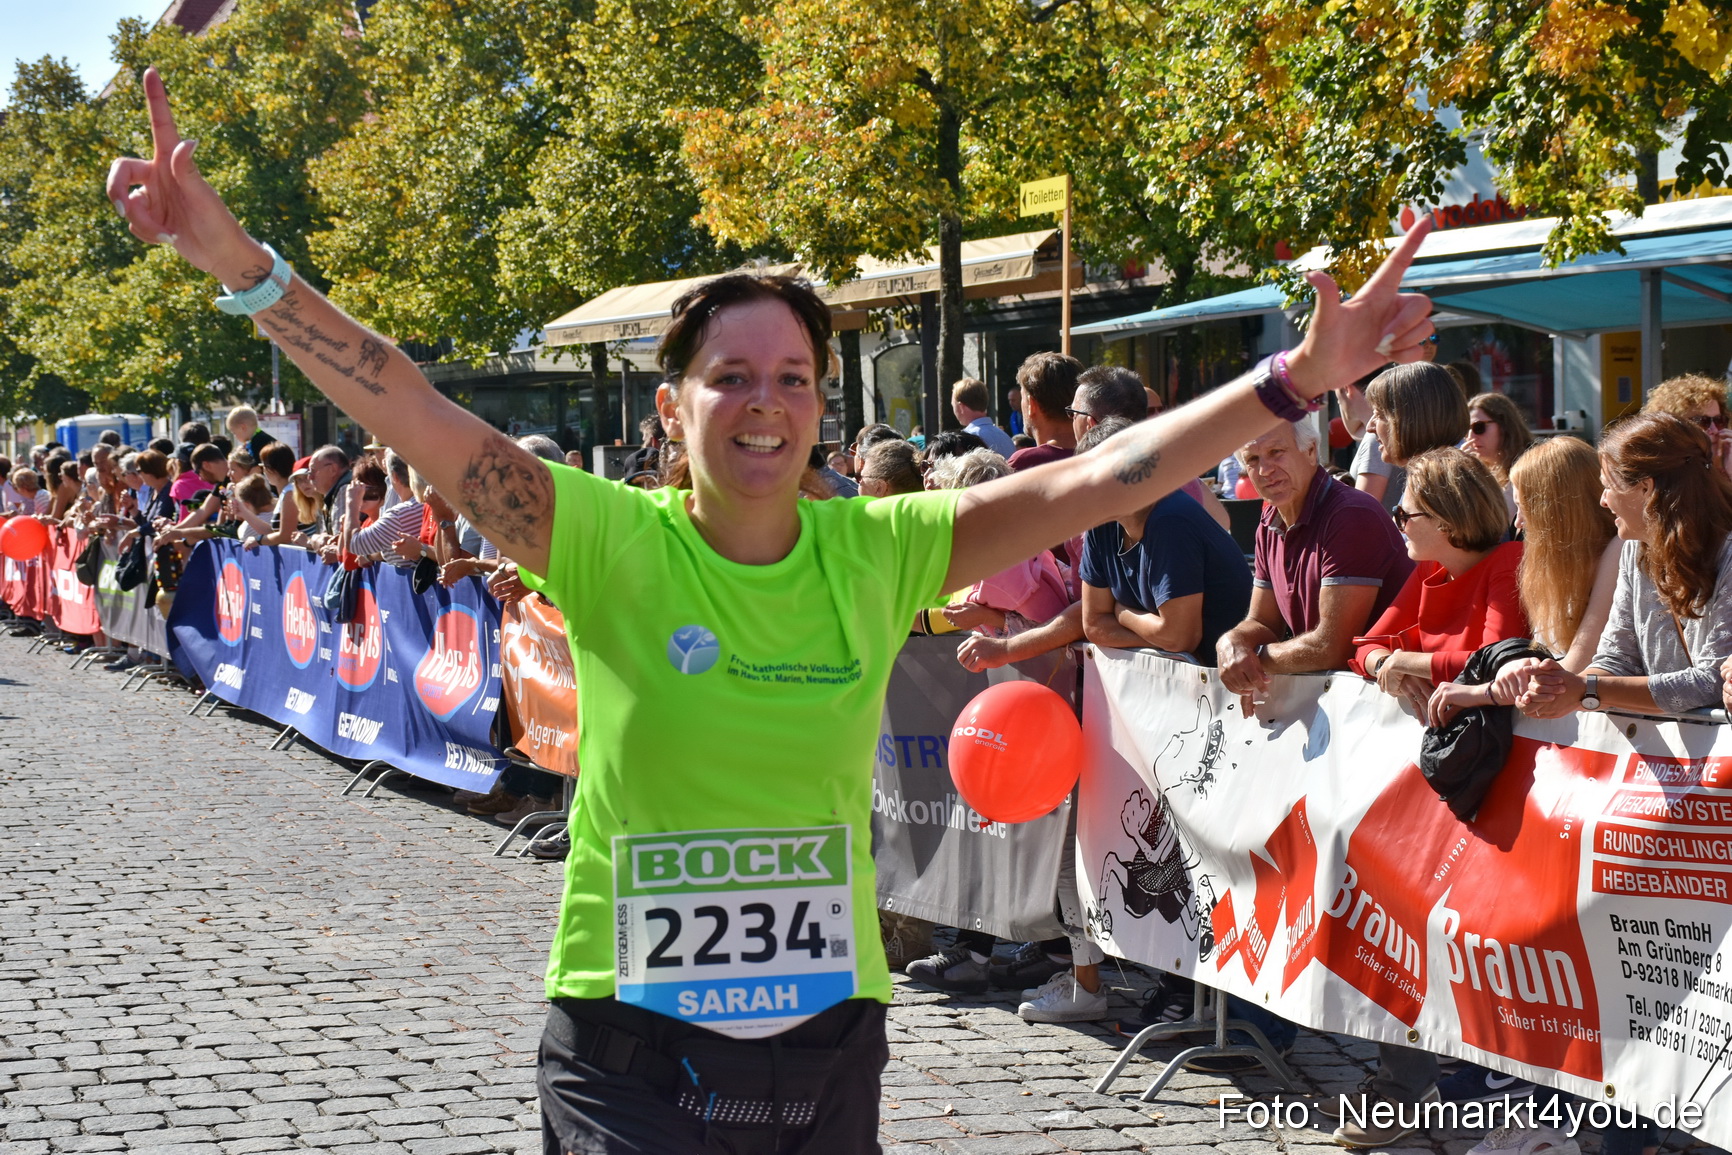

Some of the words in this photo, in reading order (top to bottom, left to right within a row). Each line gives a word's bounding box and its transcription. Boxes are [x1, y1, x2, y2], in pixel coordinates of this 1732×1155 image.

[1030, 189, 1063, 205] Toiletten
[1434, 194, 1536, 228] vodafo
[286, 593, 315, 646] Hervis
[421, 632, 478, 695] Hervis
[728, 666, 738, 675] im
[741, 670, 759, 680] Haus
[761, 674, 773, 682] St.
[776, 674, 804, 684] Marien,
[753, 663, 807, 673] katholische
[482, 697, 499, 712] MOBI
[528, 718, 569, 749] Agentur
[975, 739, 1005, 752] energie
[445, 742, 464, 768] GET
[876, 734, 948, 768] STR
[1634, 761, 1721, 782] BINDESTRICKE
[1616, 794, 1732, 820] VERZURRSYSTE
[635, 838, 830, 886] BOCK
[1435, 863, 1450, 881] Seit
[1450, 838, 1467, 863] 1929
[1603, 869, 1727, 898] HEBEBÄNDER
[832, 904, 841, 914] D
[1324, 862, 1420, 979] Braun
[645, 902, 827, 968] 2234
[1246, 902, 1266, 961] Braun
[1287, 896, 1312, 959] Braun
[1610, 914, 1659, 935] Braun
[1665, 919, 1711, 942] GmbH
[1443, 906, 1583, 1010] Braun
[1619, 938, 1641, 957] Am
[1647, 940, 1711, 974] Grünberg
[1715, 952, 1722, 973] 8
[1356, 946, 1383, 973] Sicher
[1385, 967, 1398, 983] ist
[1398, 974, 1425, 1004] sicher
[1622, 961, 1678, 987] D-92318
[678, 985, 798, 1015] SARAH
[1498, 1006, 1535, 1030] Sicher
[1541, 1015, 1558, 1033] ist
[1563, 1019, 1600, 1042] sicher
[1627, 995, 1650, 1016] Tel.
[1656, 1001, 1688, 1026] 09181
[1691, 1009, 1698, 1030] /
[1699, 1013, 1730, 1041] 2307-0
[1630, 1020, 1651, 1042] Fax
[1656, 1026, 1686, 1052] 09181
[1689, 1035, 1696, 1056] /
